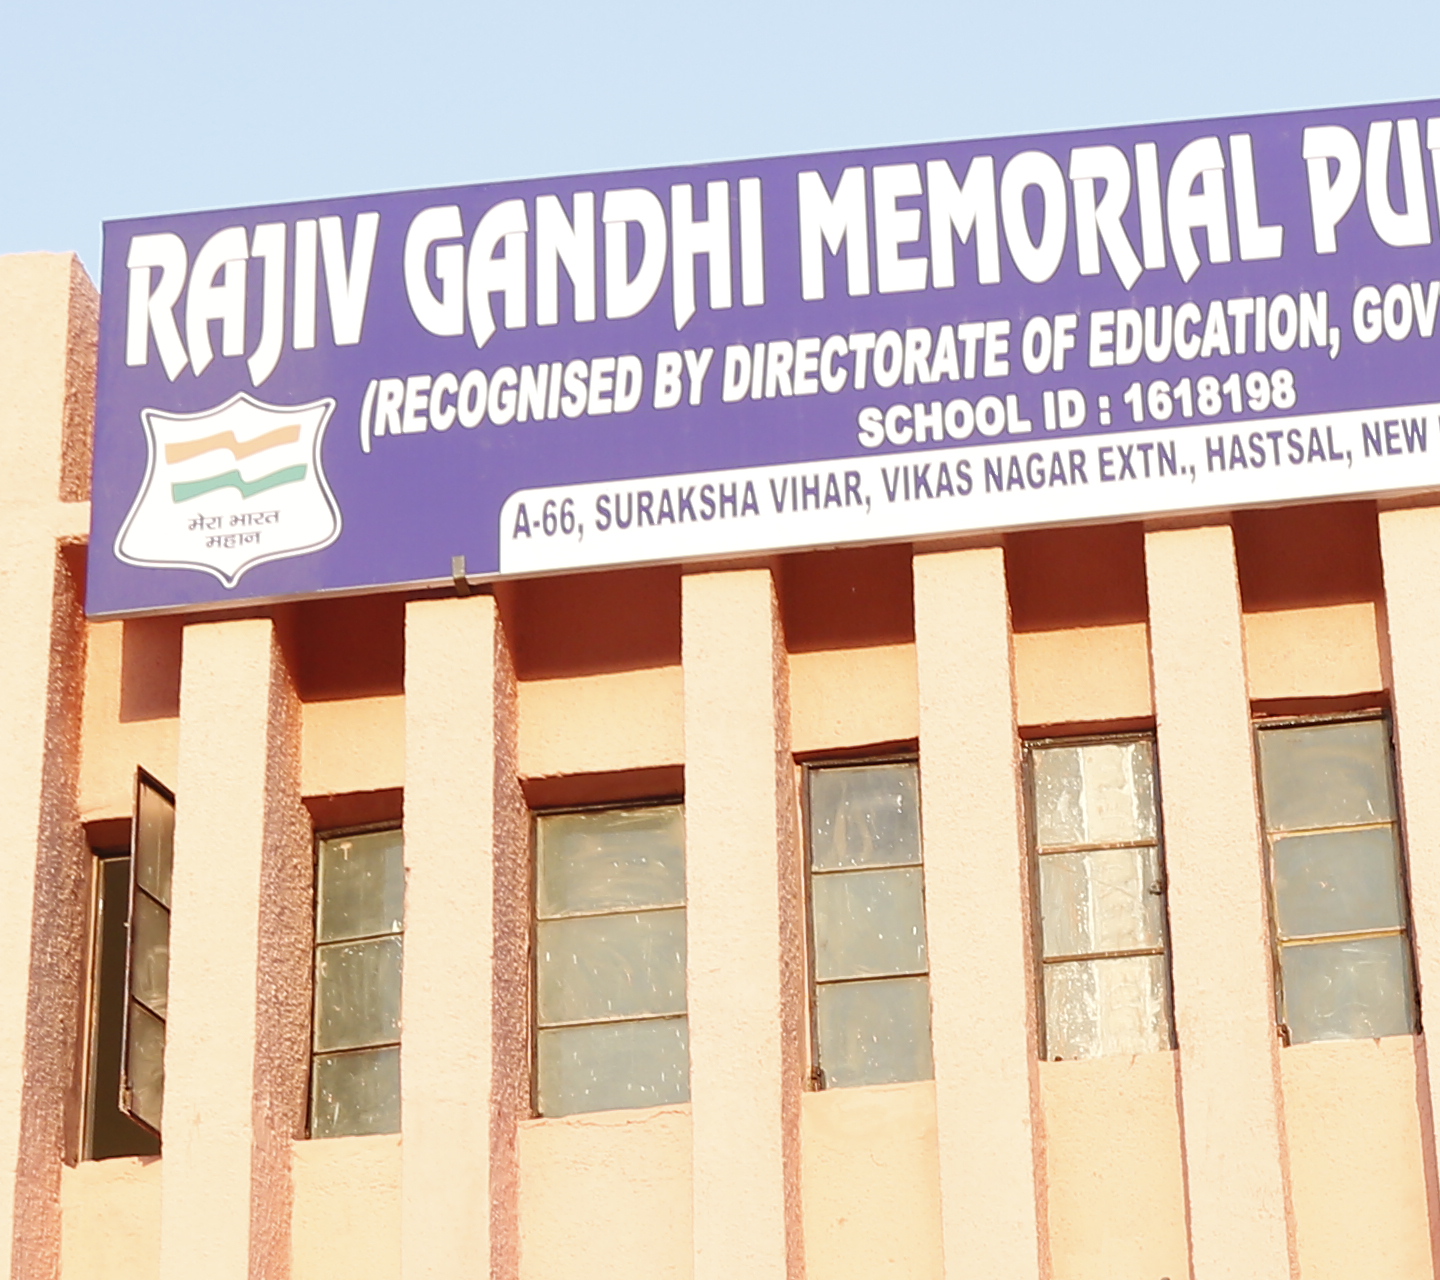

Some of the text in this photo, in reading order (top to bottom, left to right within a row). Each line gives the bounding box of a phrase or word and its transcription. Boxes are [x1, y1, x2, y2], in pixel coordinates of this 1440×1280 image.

[125, 211, 380, 388] RAJIV
[403, 176, 764, 349] GANDHI
[797, 132, 1284, 301] MEMORIAL
[360, 355, 643, 454] (RECOGNISED
[653, 348, 715, 410] BY
[722, 318, 1011, 404] DIRECTORATE
[1021, 314, 1077, 374] OF
[1088, 291, 1341, 368] EDUCATION,
[858, 394, 1031, 449] SCHOOL
[1044, 389, 1088, 432] ID
[1124, 369, 1298, 424] 1618198
[187, 508, 280, 533] मेरा भारत
[512, 501, 585, 544] A-66,
[595, 480, 759, 535] SURAKSHA
[770, 470, 871, 515] VIHAR,
[880, 459, 973, 503] VIKAS
[984, 447, 1088, 493] NAGAR
[1098, 439, 1197, 483] EXTN.,
[1205, 427, 1353, 474] HASTSAL,
[1361, 417, 1429, 458] NEW
[205, 529, 260, 549] महान
